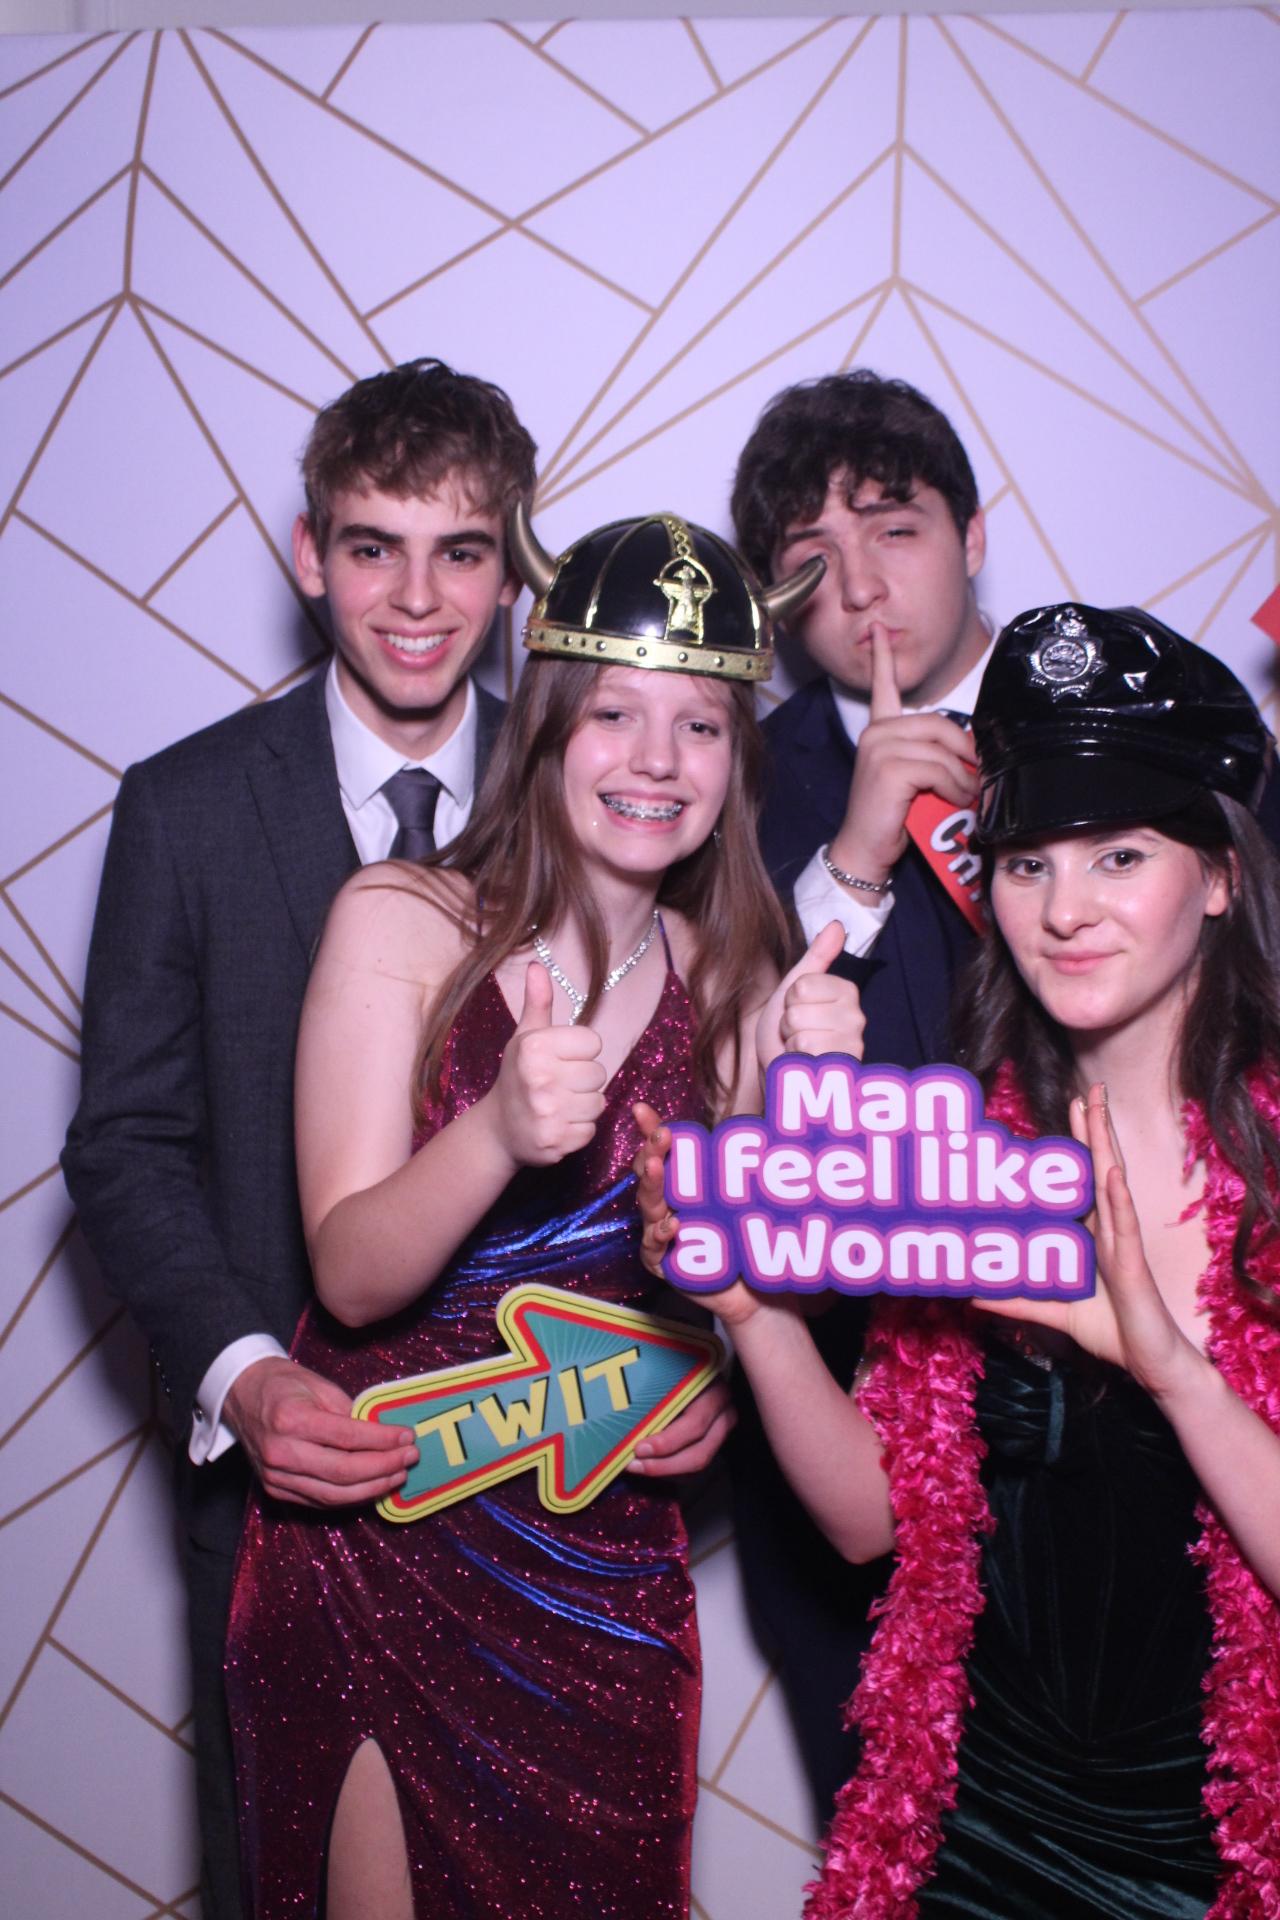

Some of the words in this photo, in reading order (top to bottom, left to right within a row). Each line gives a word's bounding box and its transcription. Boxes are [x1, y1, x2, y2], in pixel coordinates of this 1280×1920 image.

[781, 1070, 967, 1133] Man
[676, 1138, 698, 1198] I
[724, 1133, 892, 1201] feel
[920, 1133, 1081, 1204] like
[676, 1227, 724, 1276] a
[746, 1218, 1079, 1284] Woman
[414, 1346, 641, 1467] TWIT
